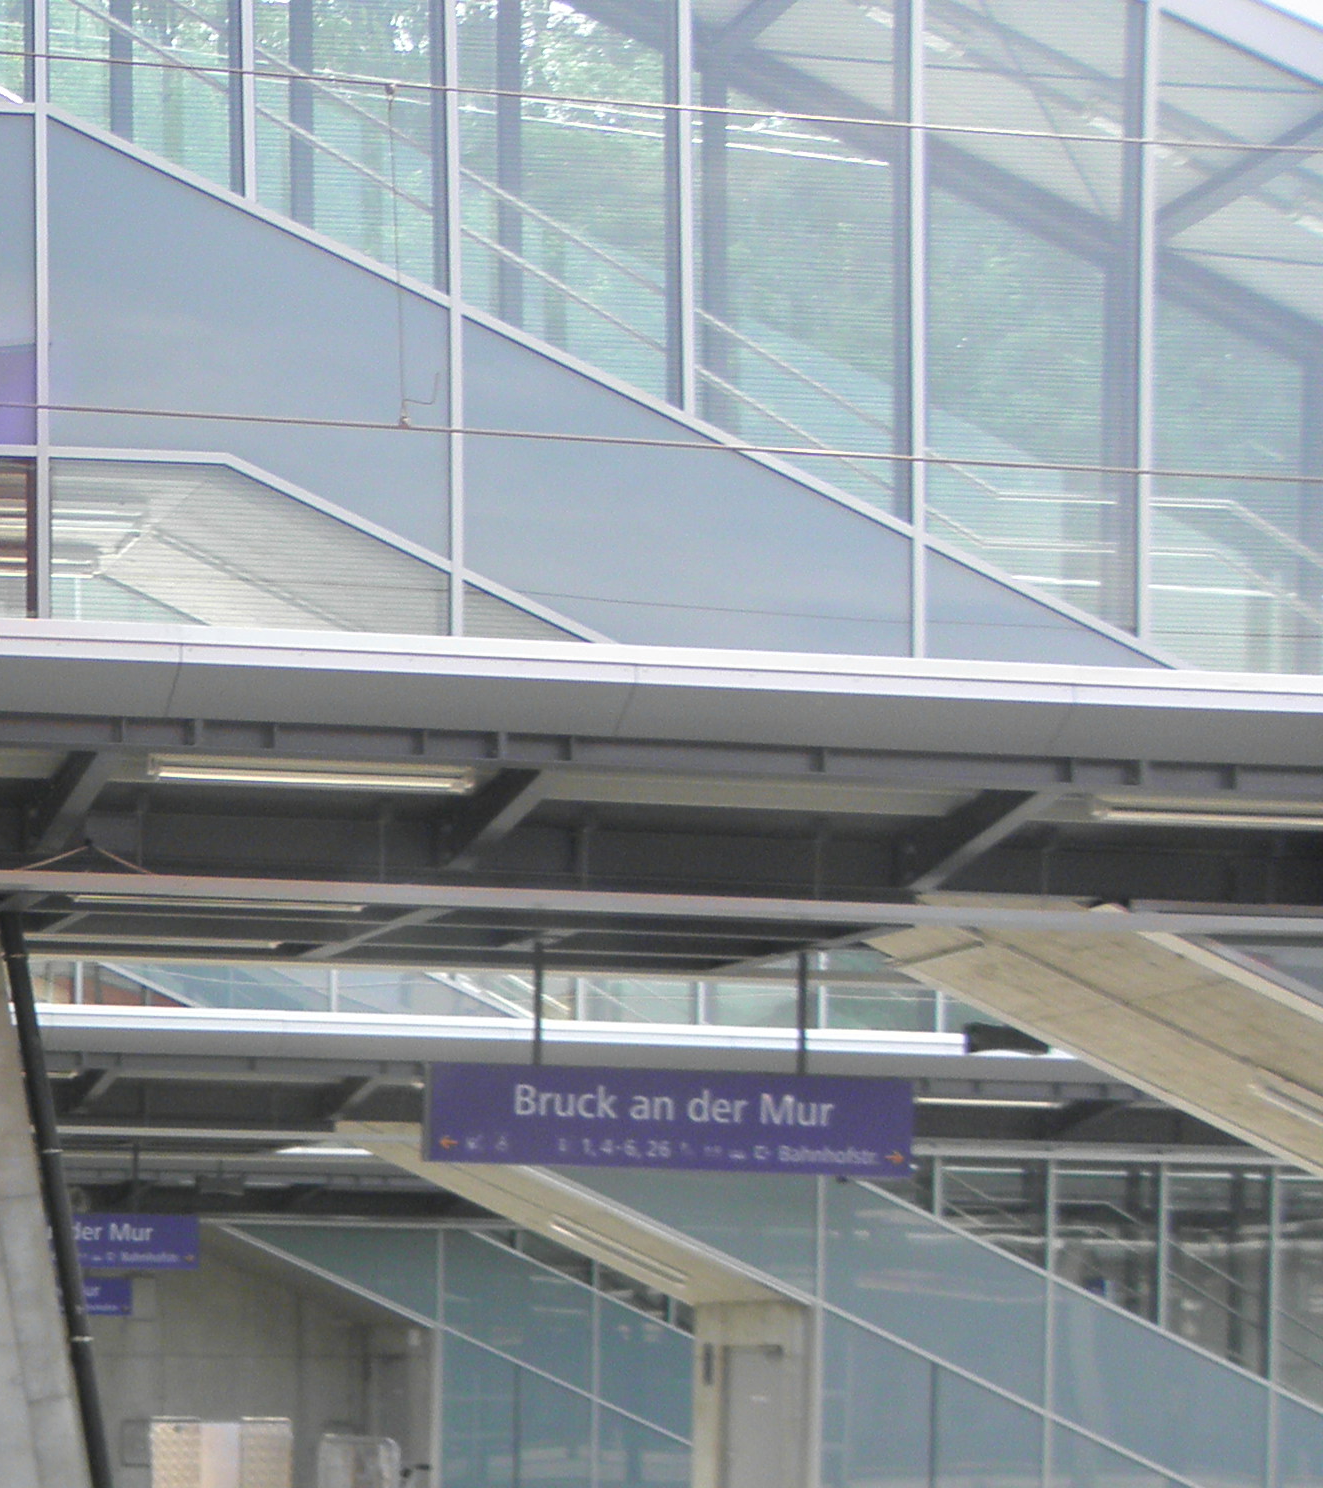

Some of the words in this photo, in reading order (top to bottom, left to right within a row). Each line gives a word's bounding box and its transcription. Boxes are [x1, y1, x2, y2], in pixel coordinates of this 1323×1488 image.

[514, 1083, 619, 1119] Bruck
[630, 1095, 678, 1121] an
[688, 1088, 749, 1123] der
[759, 1092, 836, 1127] Mur
[108, 1221, 155, 1242] Mur
